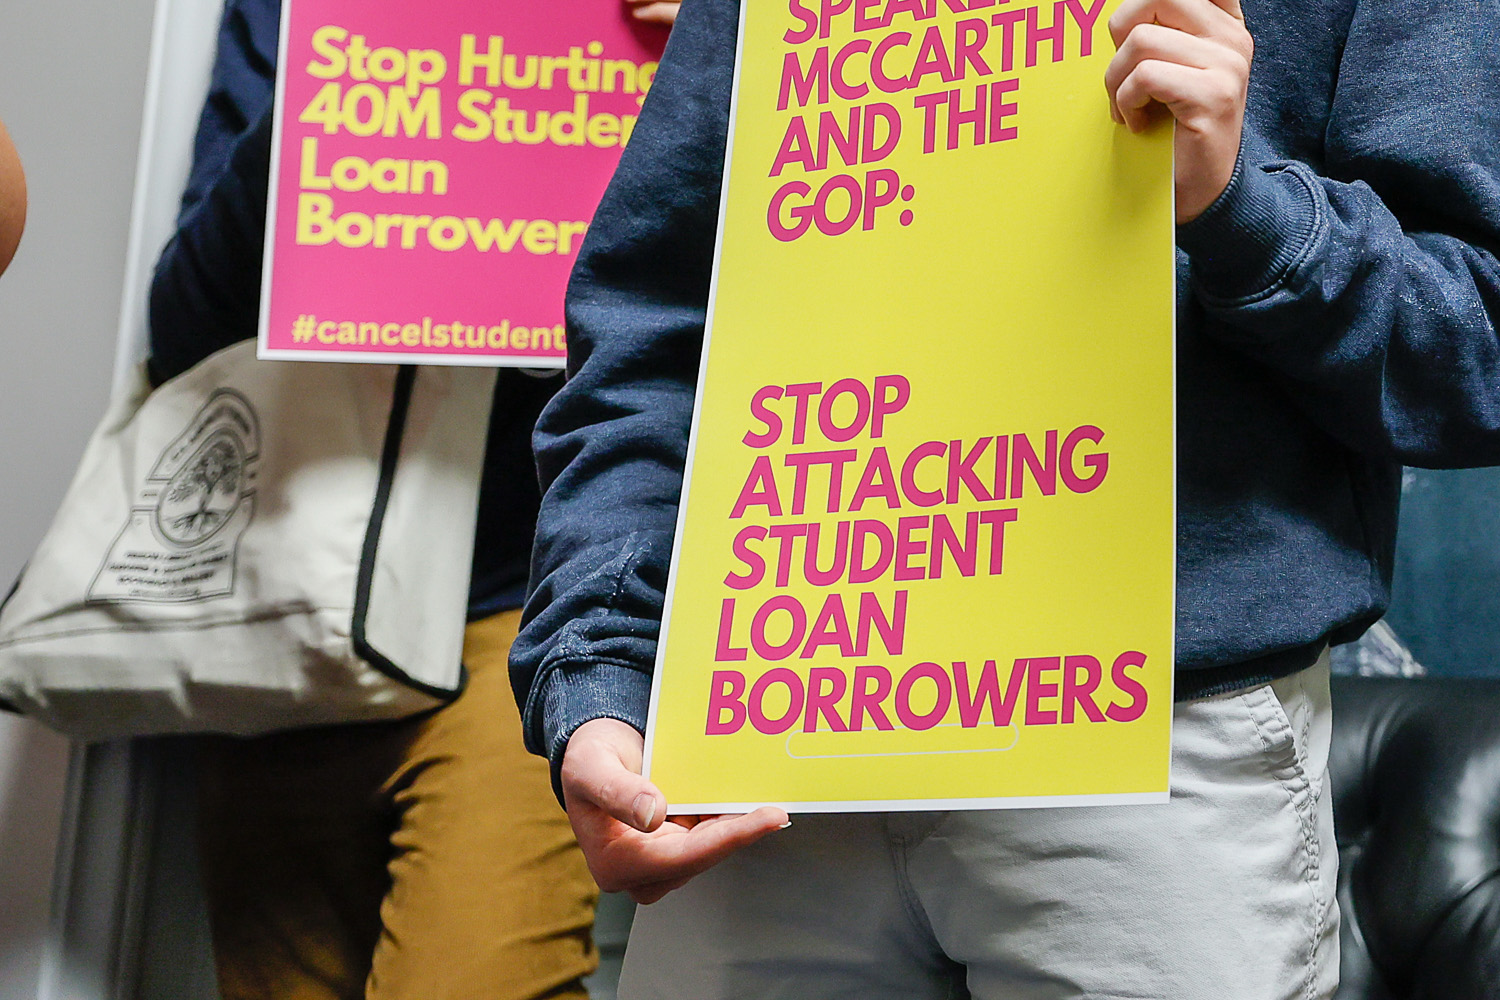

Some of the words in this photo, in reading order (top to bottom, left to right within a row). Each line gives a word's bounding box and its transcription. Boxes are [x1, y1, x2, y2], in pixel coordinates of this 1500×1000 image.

[306, 26, 447, 98] Stop
[299, 82, 442, 139] 40M
[452, 89, 639, 148] Stude
[769, 102, 902, 178] AND
[914, 78, 1019, 154] THE
[300, 137, 448, 194] Loan
[296, 193, 588, 255] Borrower
[767, 168, 915, 243] GOP:
[292, 314, 567, 350] #cancelstudent
[742, 374, 917, 449] STOP
[729, 425, 1109, 519] ATTACKING
[723, 508, 1018, 591] STUDENT
[715, 589, 908, 662] LOAN
[705, 650, 1149, 736] BORROWERS
